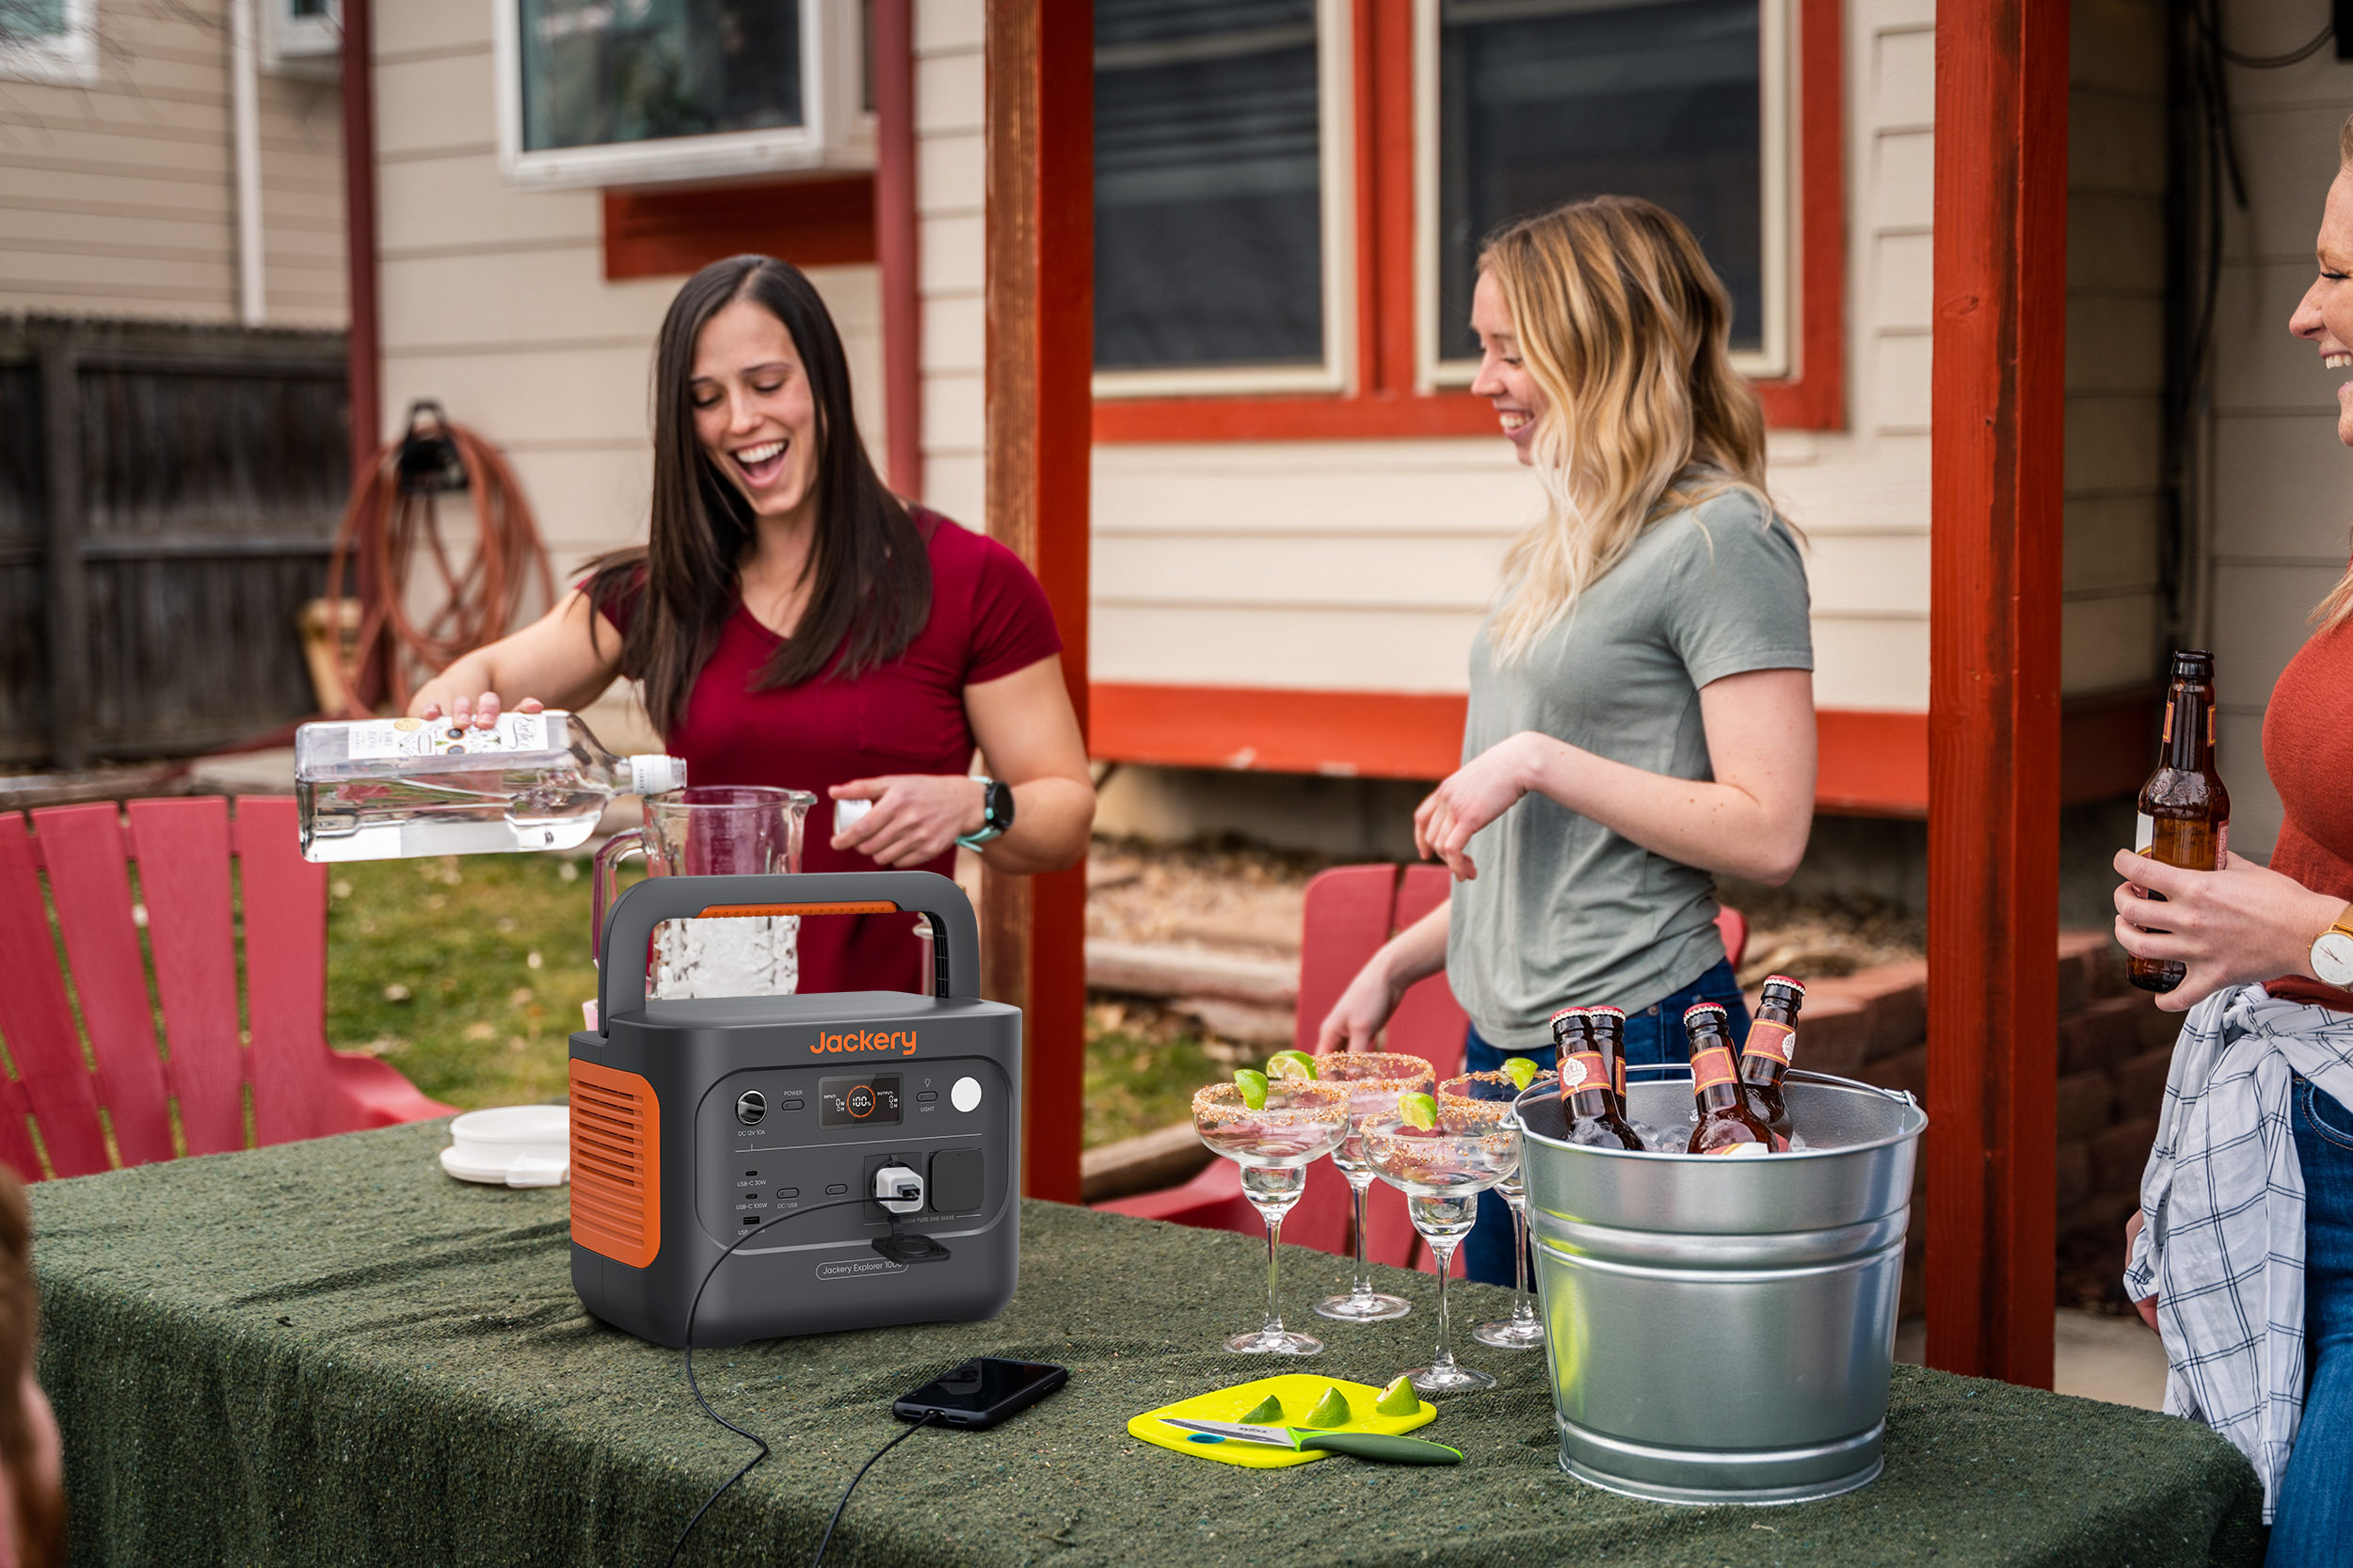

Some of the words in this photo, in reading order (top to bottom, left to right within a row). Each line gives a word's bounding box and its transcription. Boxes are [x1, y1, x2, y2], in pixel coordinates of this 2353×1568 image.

[809, 1030, 917, 1056] Jackery
[852, 1096, 872, 1107] 100%
[823, 1266, 852, 1274] Jackery
[853, 1262, 883, 1272] Explorer
